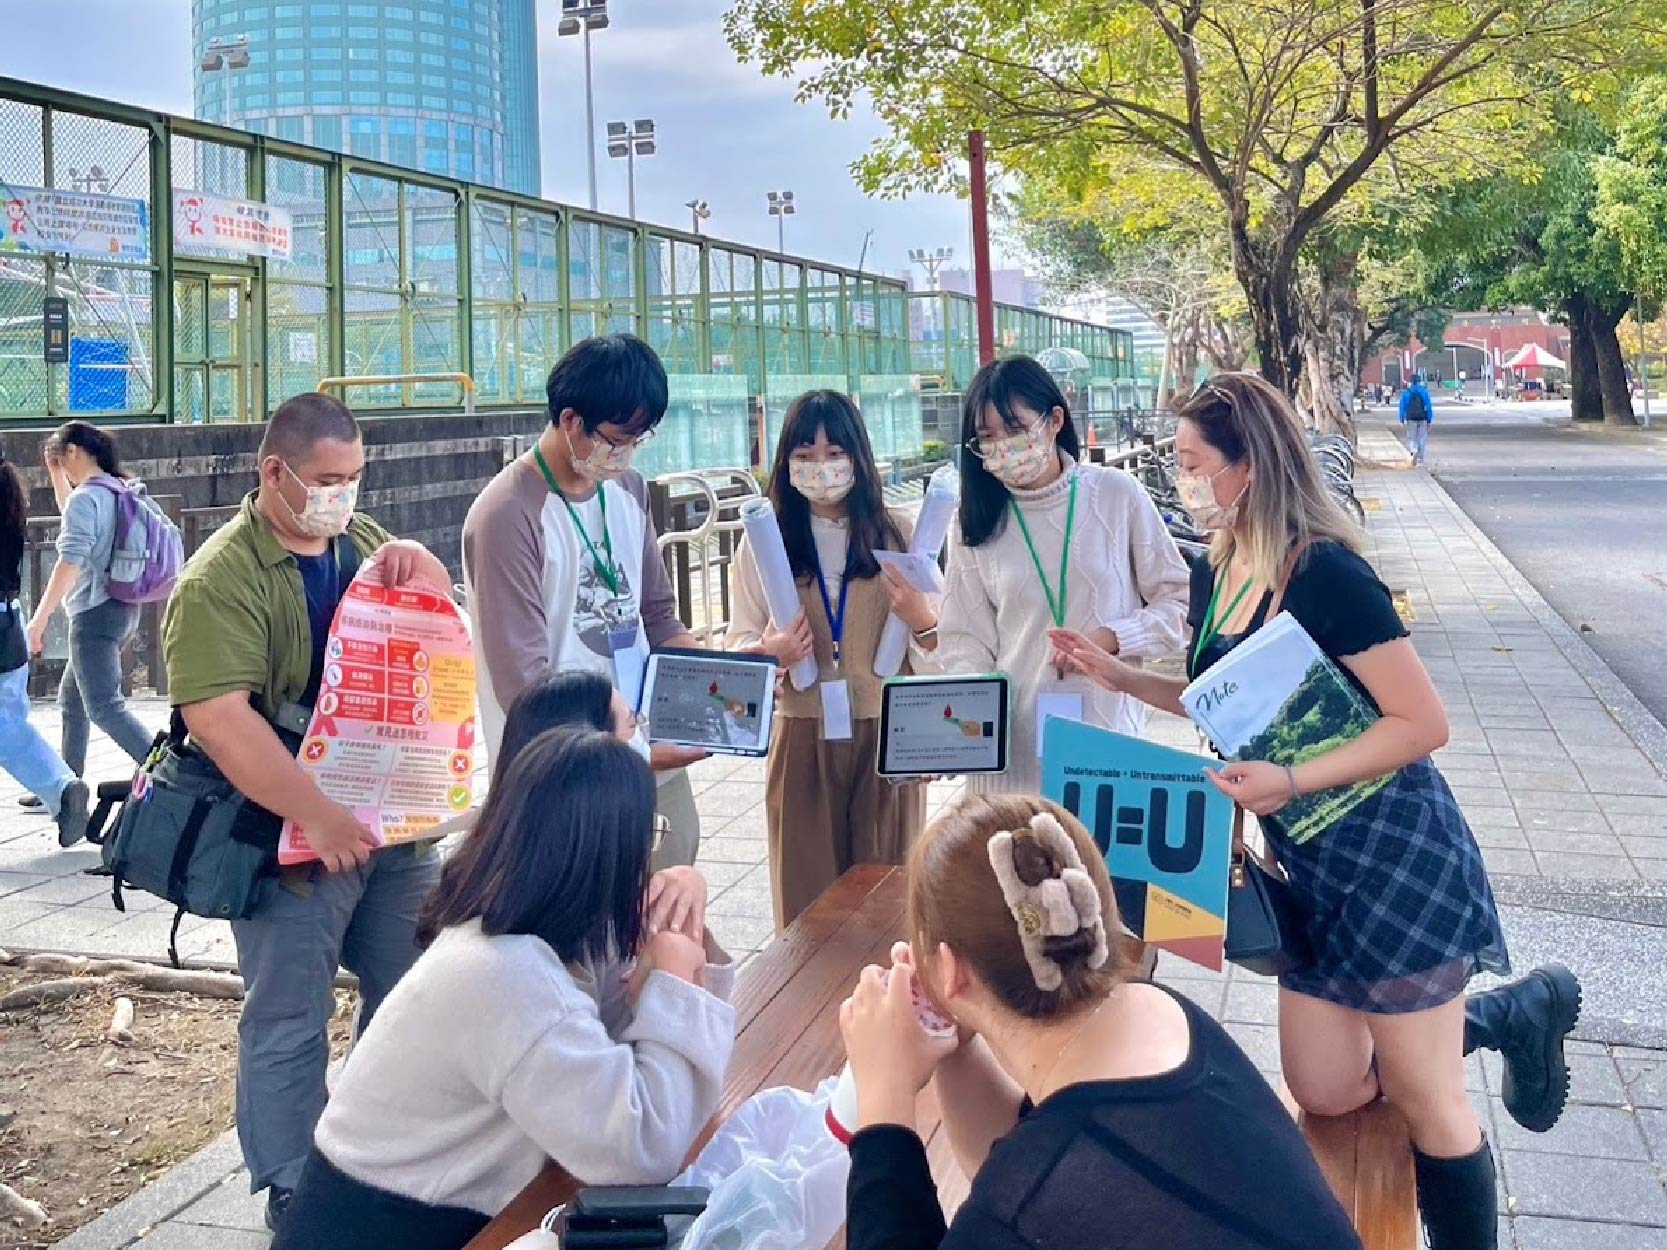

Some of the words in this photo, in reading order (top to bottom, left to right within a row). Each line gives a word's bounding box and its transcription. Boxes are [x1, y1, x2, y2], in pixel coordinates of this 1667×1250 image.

[1196, 682, 1239, 711] Note
[1063, 766, 1121, 778] Undetectable
[1130, 769, 1205, 783] Untransmittable
[1063, 780, 1205, 873] U=U
